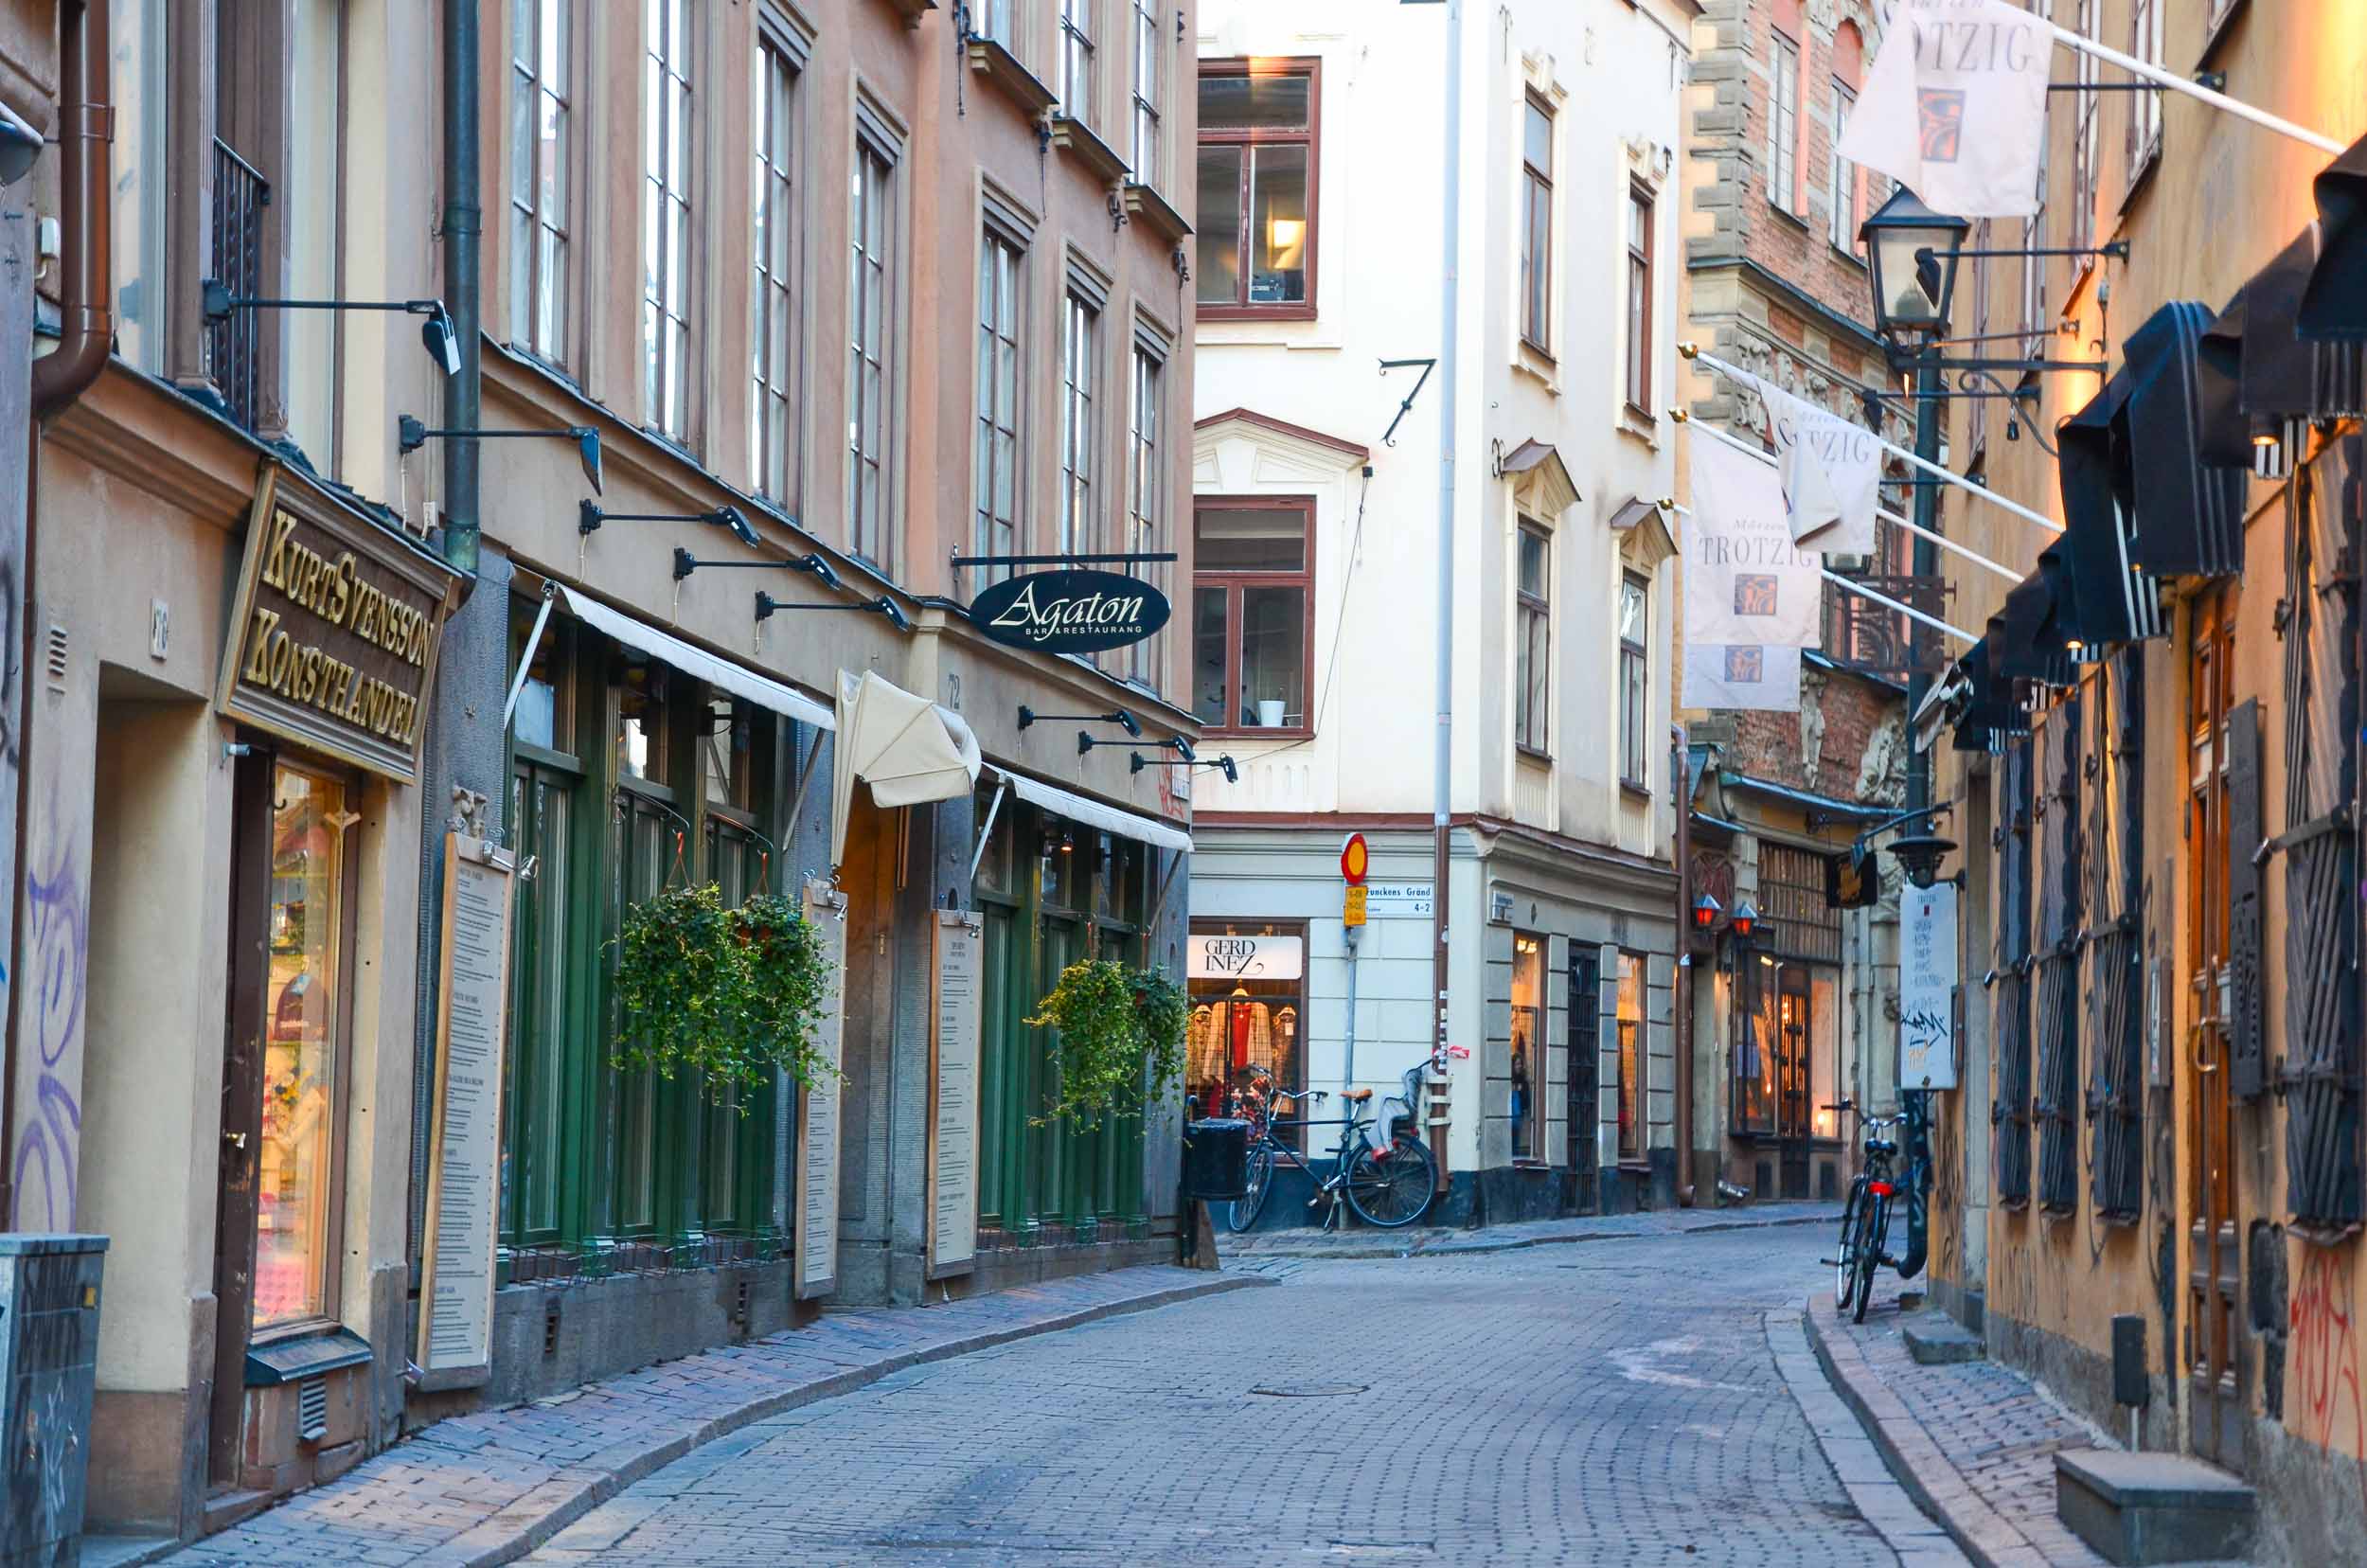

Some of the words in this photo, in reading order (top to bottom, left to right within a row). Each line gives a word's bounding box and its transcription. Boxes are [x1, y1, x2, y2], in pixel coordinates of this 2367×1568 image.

[1699, 535, 1811, 567] TROTZIG
[989, 580, 1144, 641] Agaton
[1063, 625, 1143, 634] RESTAURANG
[246, 607, 418, 745] KONSTHANDEL
[947, 673, 960, 709] 72
[1406, 886, 1431, 897] Gränd
[1415, 903, 1431, 912] 4-2
[1204, 938, 1256, 955] GERD
[1204, 954, 1265, 976] INEZ
